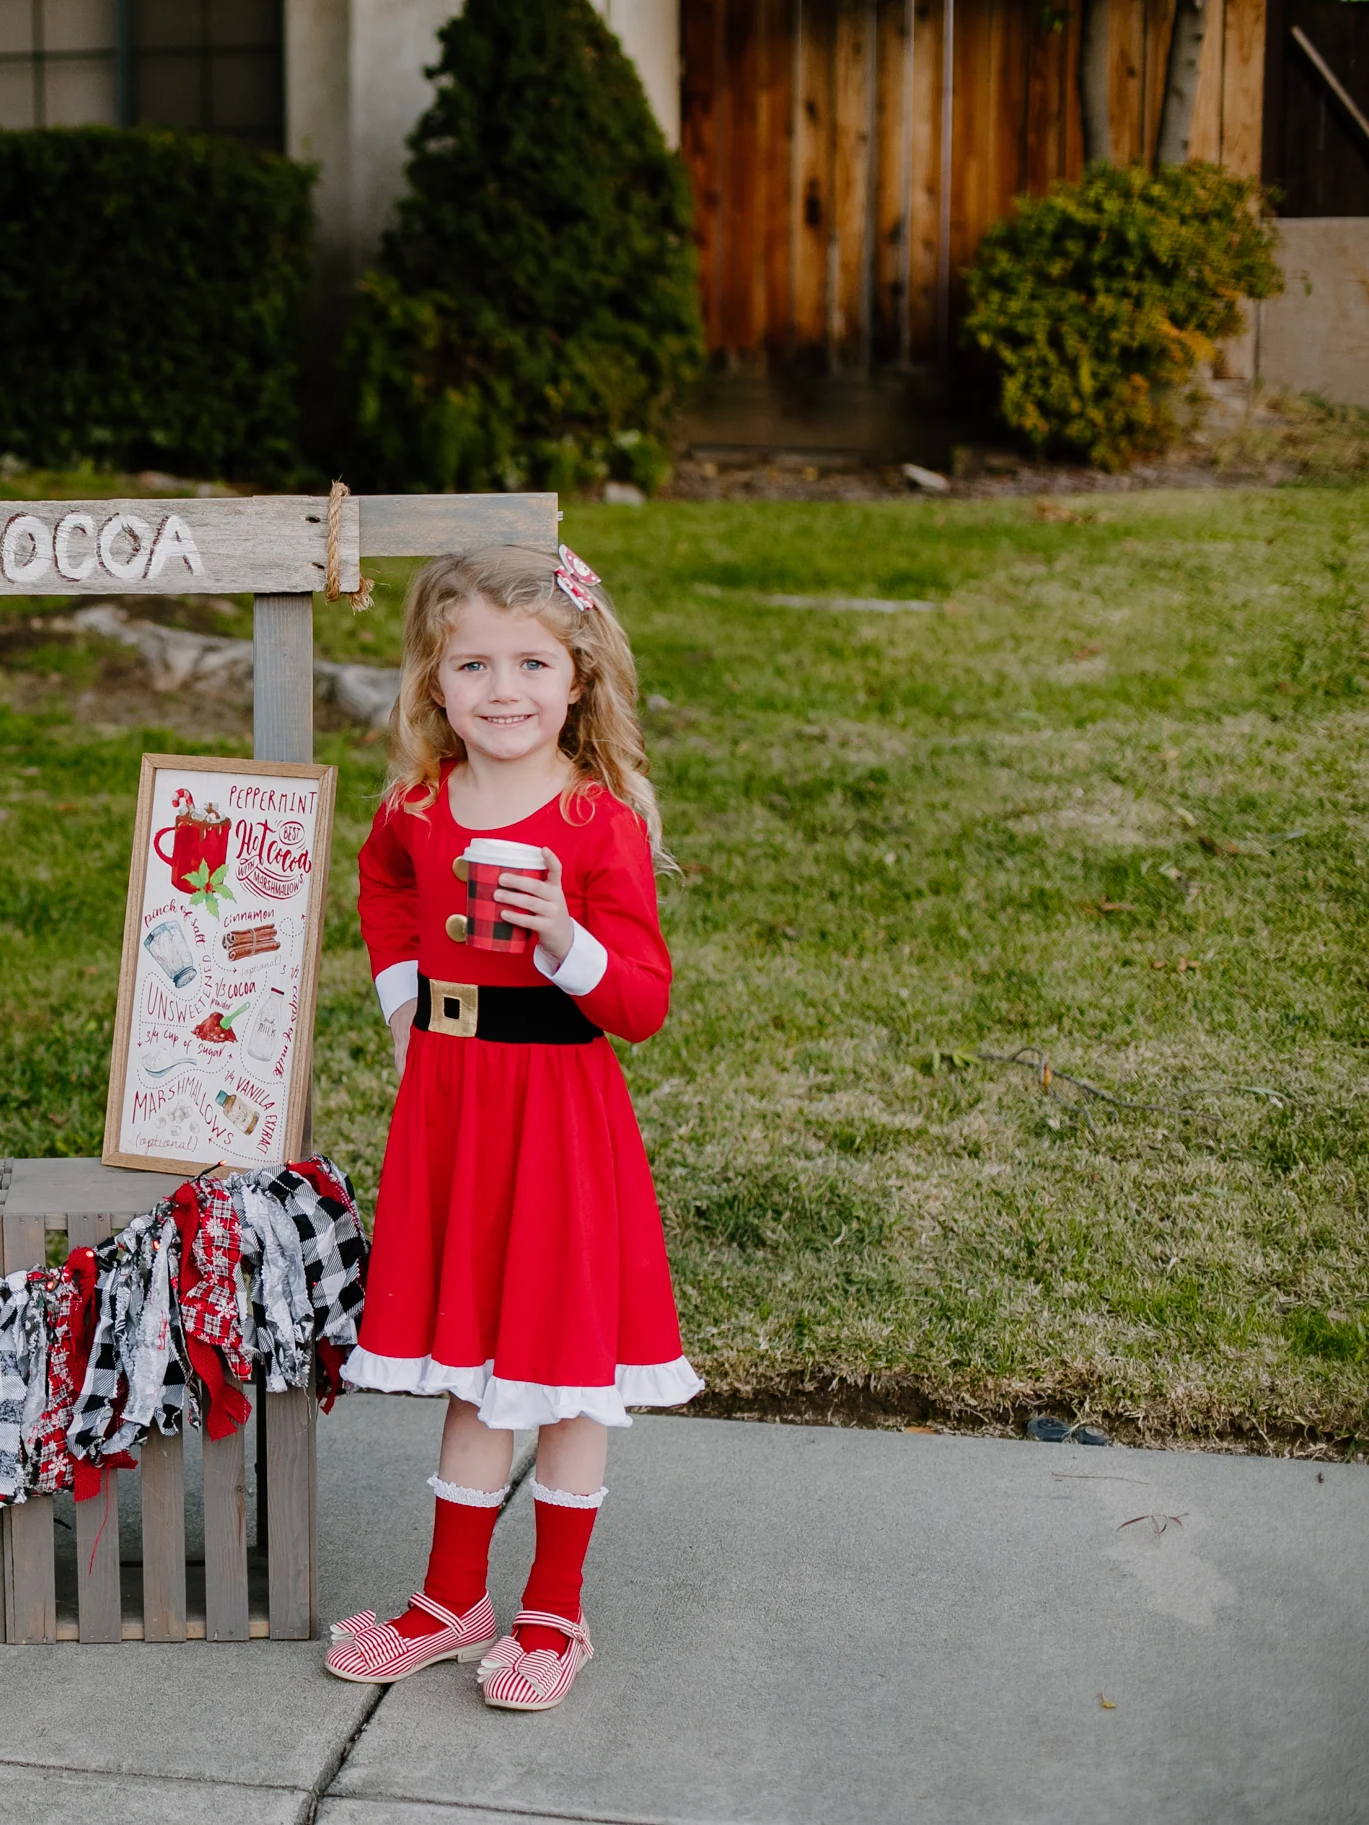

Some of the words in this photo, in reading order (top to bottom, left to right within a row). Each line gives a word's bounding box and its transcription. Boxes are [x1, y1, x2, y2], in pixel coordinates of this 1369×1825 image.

[229, 785, 317, 814] PEPPERMINT
[235, 819, 277, 865] Hot
[283, 825, 302, 841] BEST
[237, 861, 255, 876] WITH
[253, 871, 304, 897] MARSHMALLOWS
[144, 898, 177, 928] pinch
[132, 1076, 235, 1145] MARSHMALLOWS
[235, 1076, 276, 1111] VANILLA
[256, 1114, 278, 1155] EXTRACT
